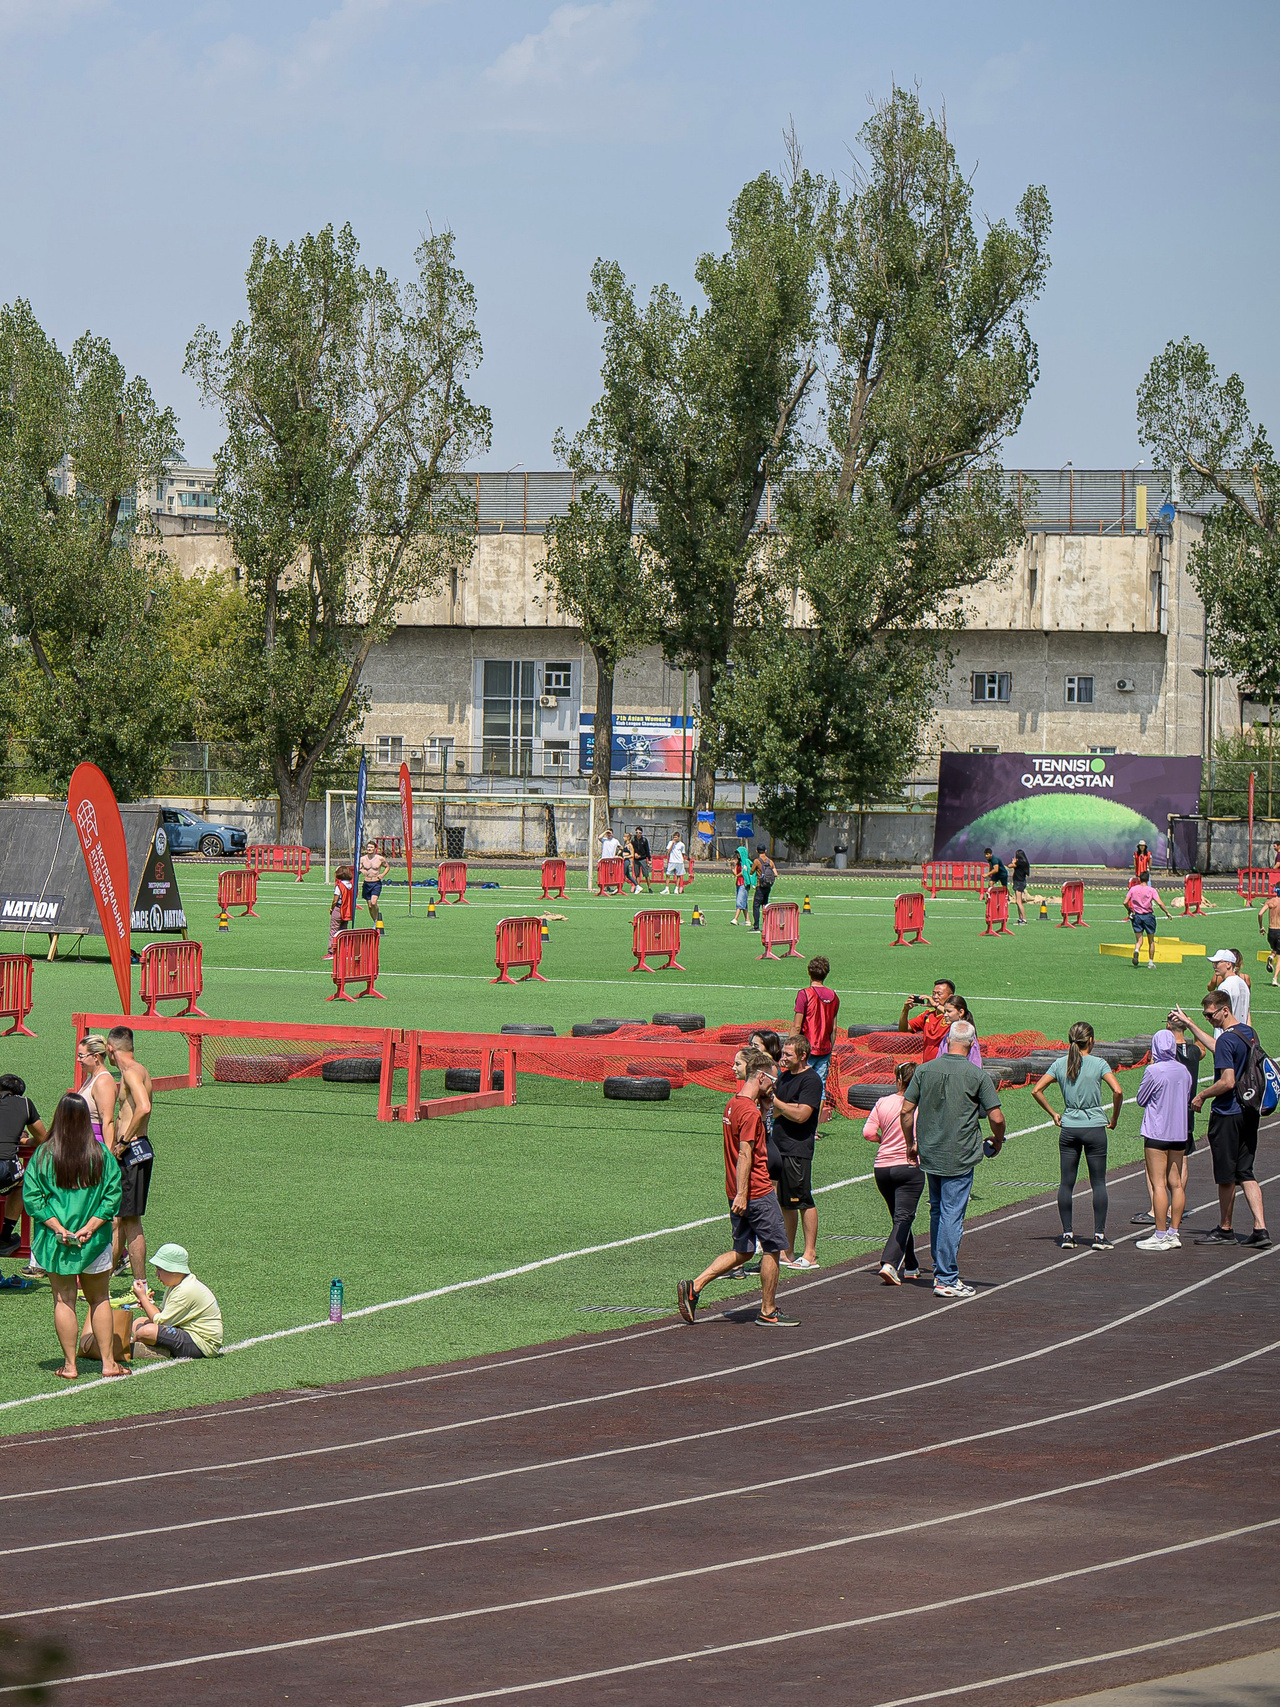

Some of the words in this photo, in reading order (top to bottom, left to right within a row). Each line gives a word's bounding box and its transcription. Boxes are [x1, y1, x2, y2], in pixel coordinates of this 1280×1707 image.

[1032, 758, 1090, 772] TENNISI
[1021, 773, 1114, 789] QAZAQSTAN
[90, 849, 109, 907] АТЛЕТИКА
[95, 841, 126, 939] ЭКСТРЕМАЛЬНАЯ
[2, 900, 59, 919] NATION
[131, 910, 149, 929] RACE
[131, 1145, 144, 1156] 51
